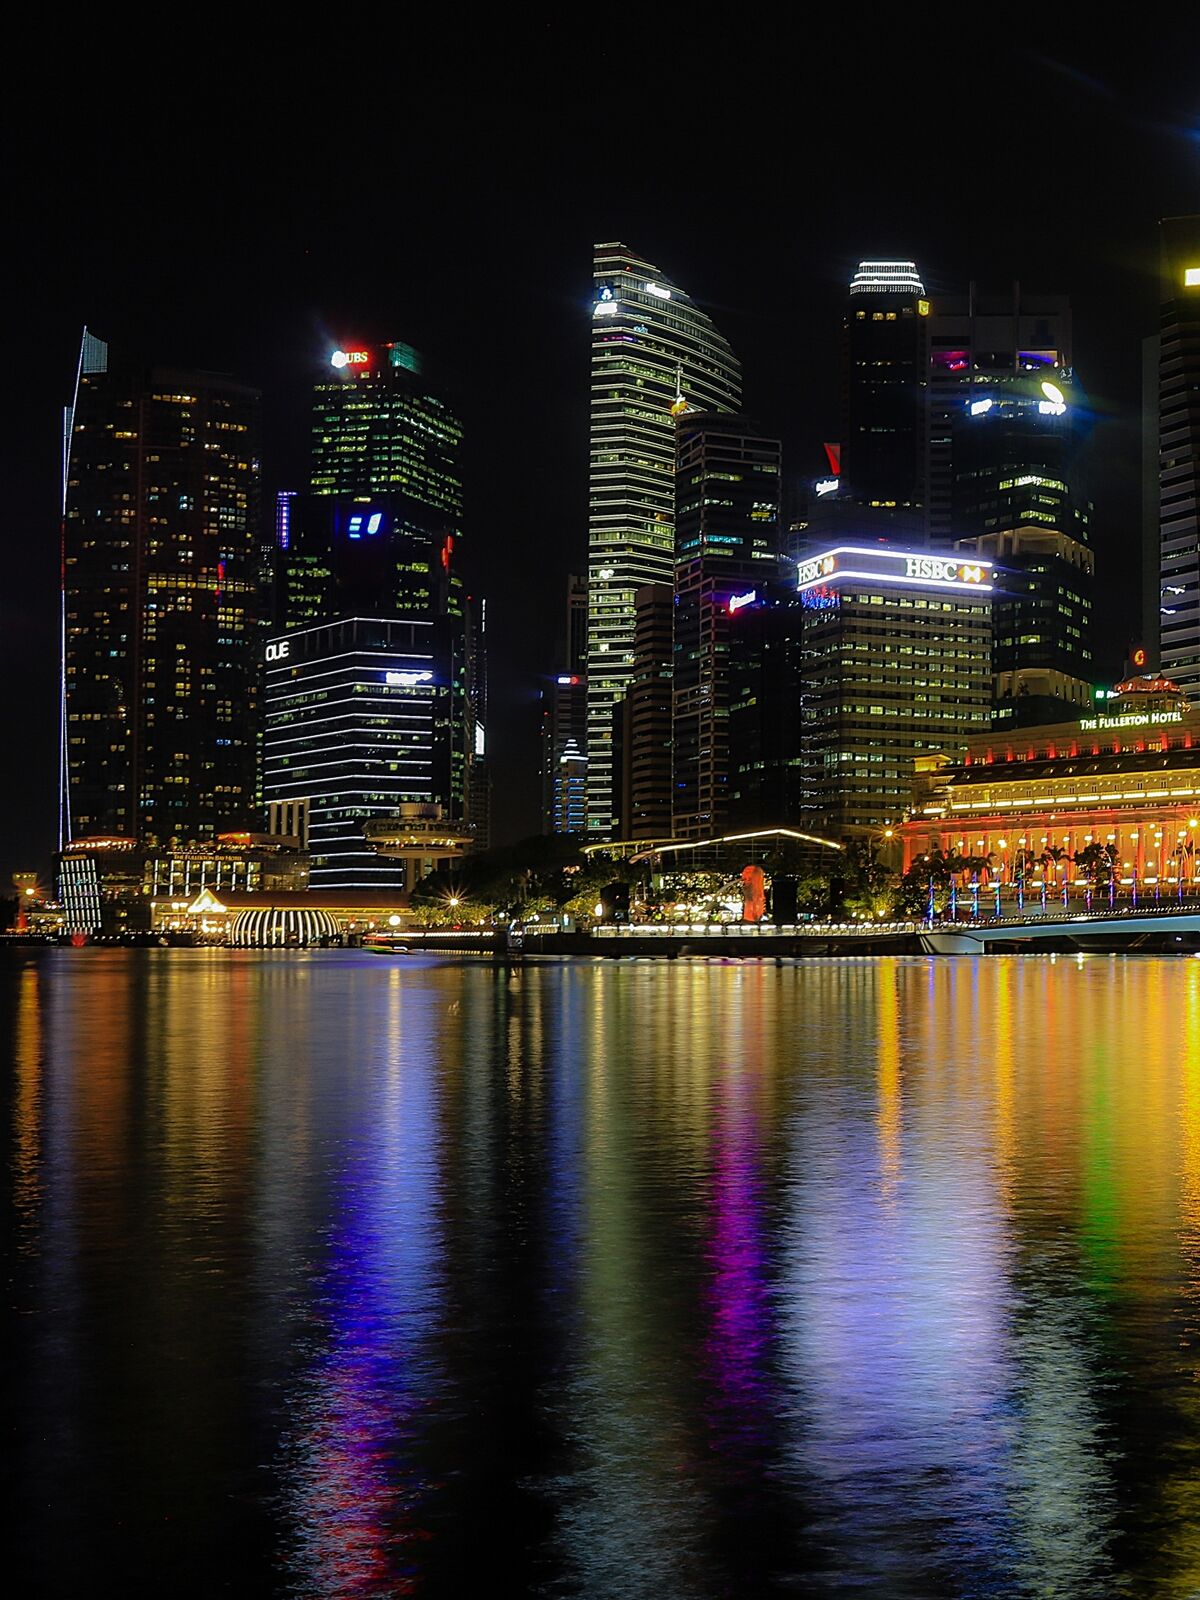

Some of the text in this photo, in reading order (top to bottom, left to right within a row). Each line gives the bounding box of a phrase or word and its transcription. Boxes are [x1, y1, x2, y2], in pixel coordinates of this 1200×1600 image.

[346, 351, 368, 364] UBS
[798, 559, 823, 585] HSBC
[906, 558, 957, 581] HSBC
[265, 641, 290, 662] OUE
[1080, 711, 1183, 731] THE FULLERTON HOTEL
